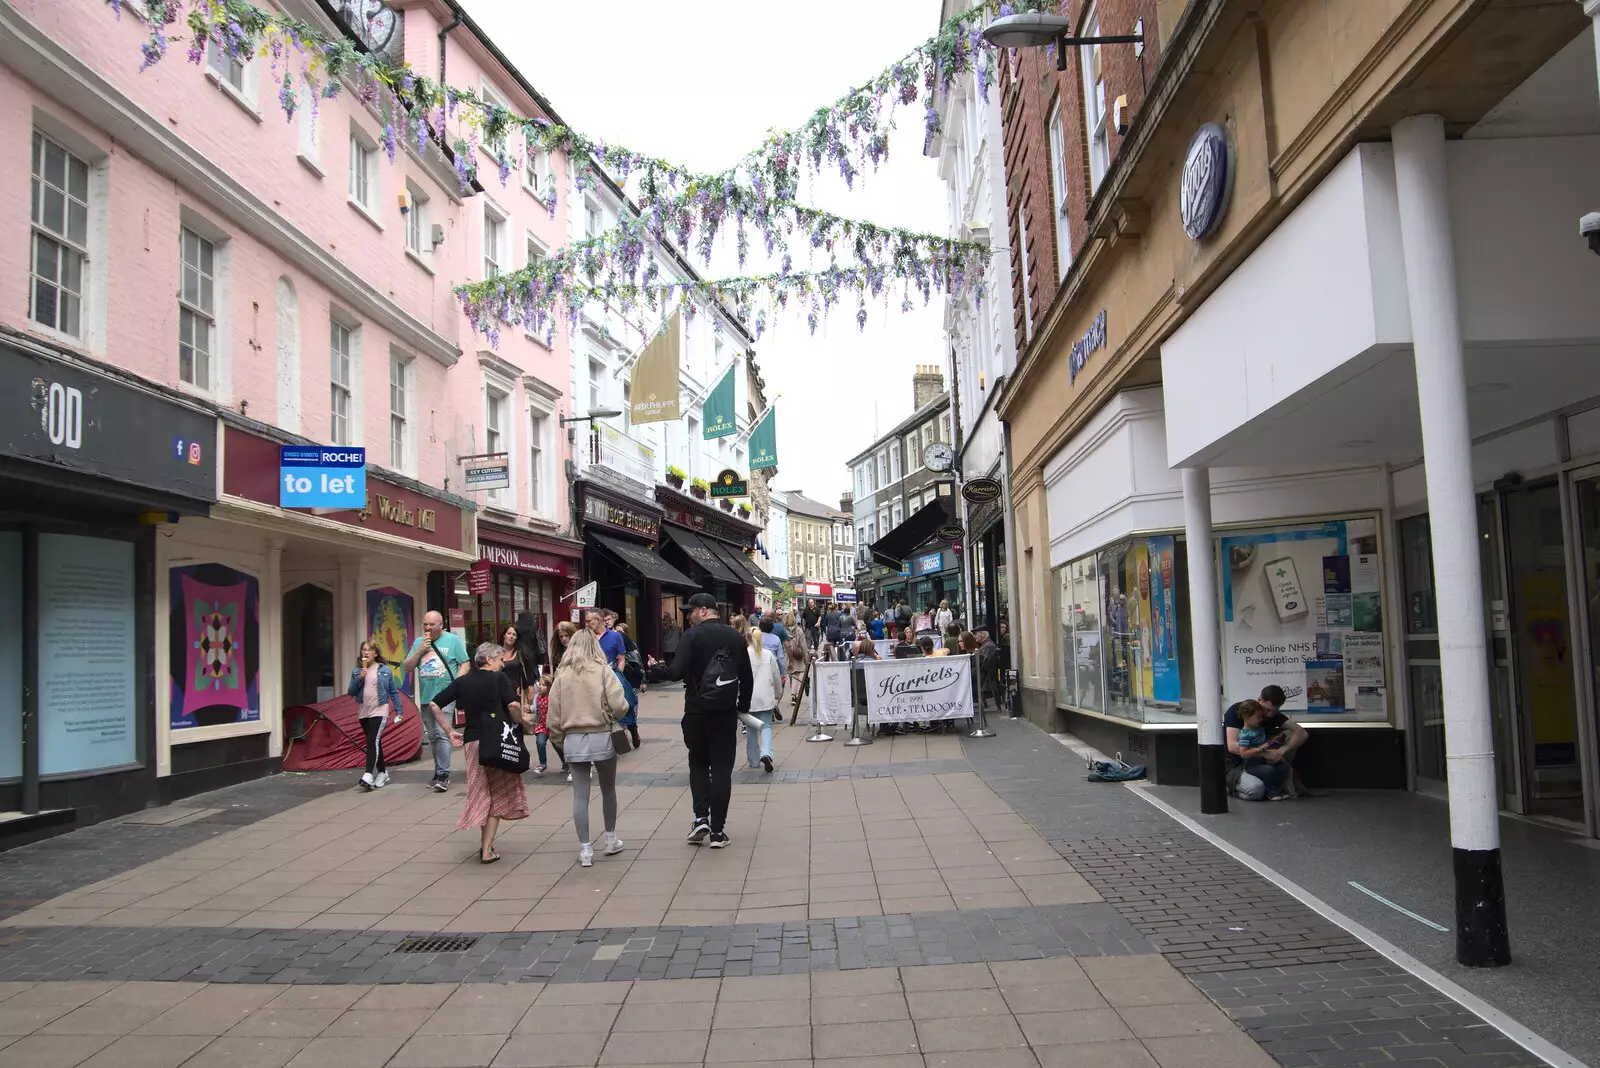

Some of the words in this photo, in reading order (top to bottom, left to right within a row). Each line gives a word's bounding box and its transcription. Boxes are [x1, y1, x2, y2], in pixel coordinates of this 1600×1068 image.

[48, 382, 83, 449] OD
[707, 422, 733, 434] ROLEX
[322, 453, 359, 463] ROCHE
[752, 455, 775, 465] ROLEX
[284, 473, 312, 493] to
[320, 473, 355, 494] let
[712, 486, 745, 495] ROLEX
[478, 545, 518, 566] TIMPSON
[1234, 645, 1254, 654] Free
[1255, 644, 1286, 653] Online
[1288, 643, 1310, 652] NHS
[1245, 655, 1299, 666] Prescription
[877, 667, 954, 698] Harriets
[908, 701, 963, 714] TEAROOMS
[501, 754, 519, 763] TESTING
[502, 749, 519, 757] ANIMAL
